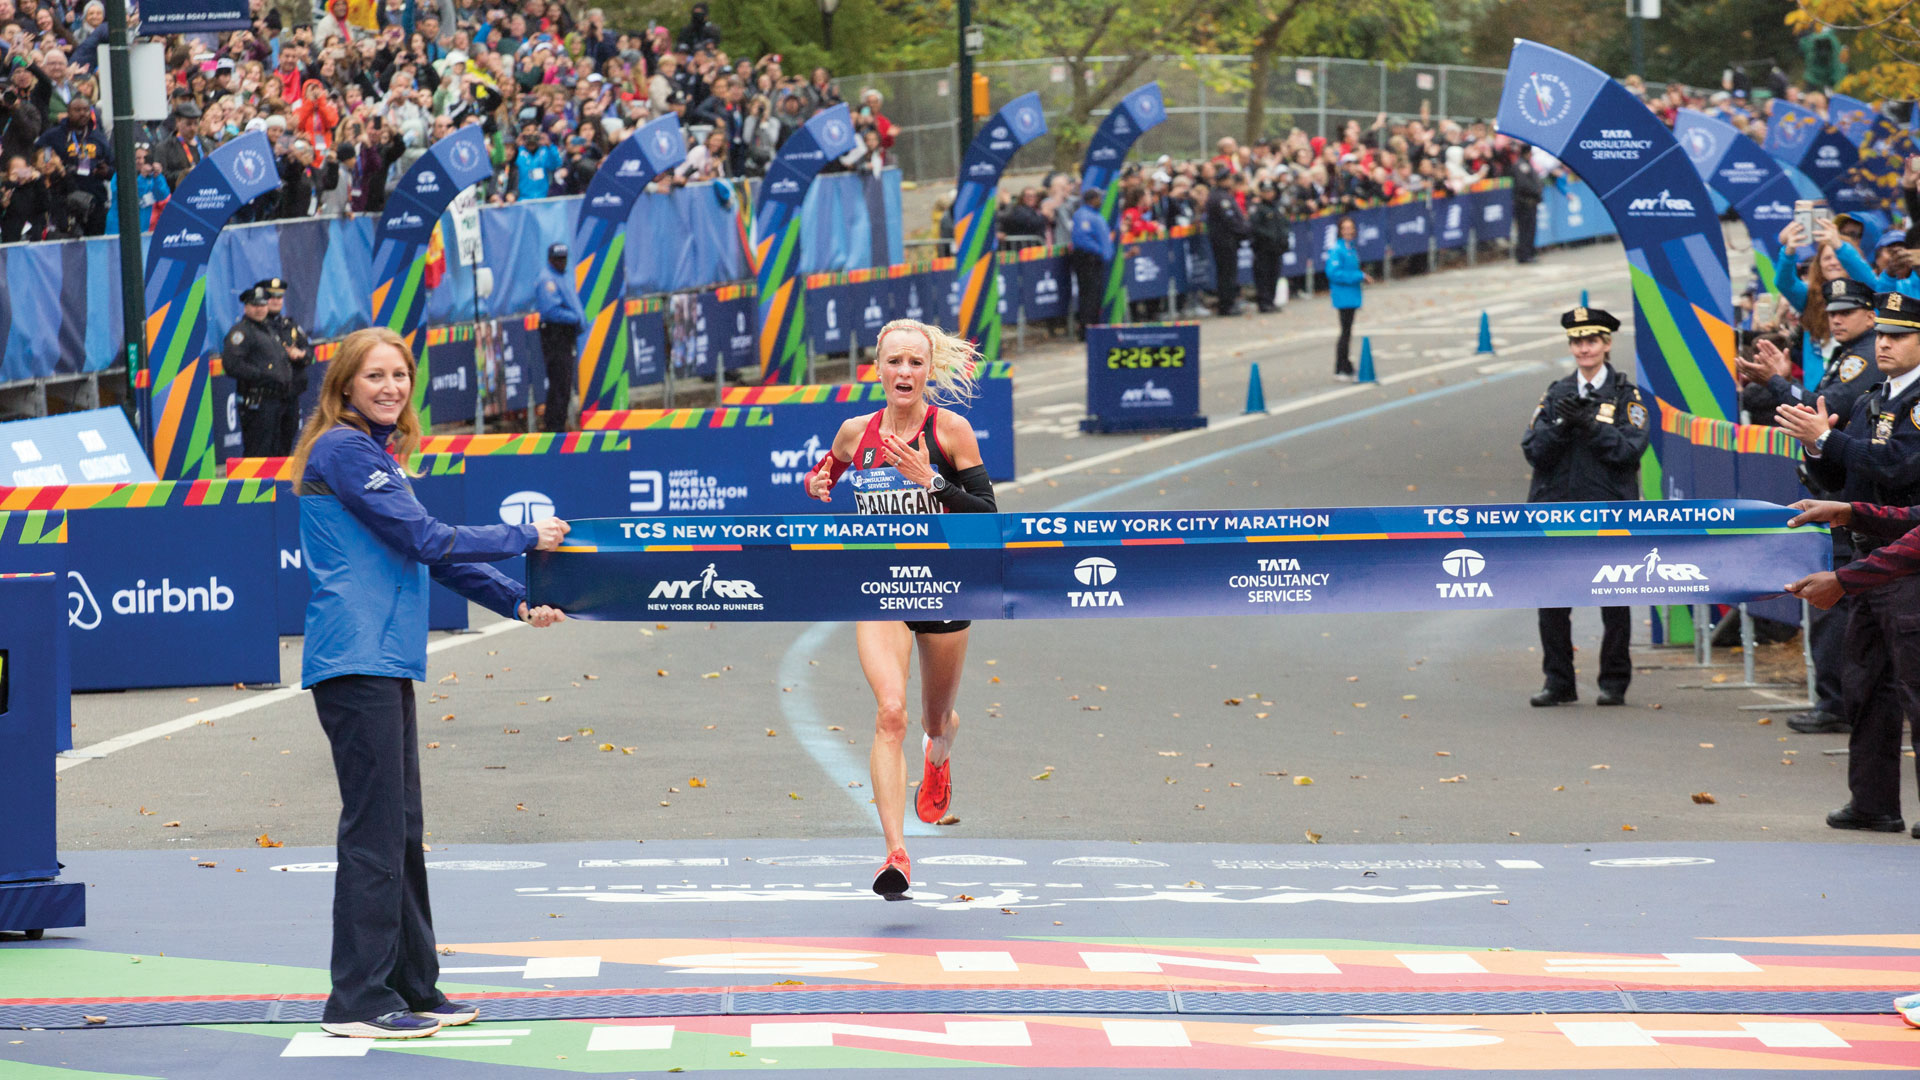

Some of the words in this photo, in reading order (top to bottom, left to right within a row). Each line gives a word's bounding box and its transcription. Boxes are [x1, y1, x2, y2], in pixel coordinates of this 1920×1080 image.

[148, 14, 166, 22] NEW
[167, 13, 186, 22] YORK
[186, 12, 207, 21] ROAD
[208, 11, 241, 20] RUNNERS
[1600, 129, 1632, 139] TATA
[1579, 140, 1652, 150] CONSULTANCY
[1592, 150, 1639, 160] SERVICES
[668, 476, 717, 489] WORLD
[668, 487, 748, 500] MARATHON
[668, 498, 725, 511] MAJORS
[1423, 508, 1469, 525] TCS
[1476, 510, 1521, 524] NEW
[1524, 509, 1576, 524] YORK
[1579, 509, 1624, 523] CITY
[1628, 507, 1736, 523] MARATHON
[620, 522, 666, 539] TCS
[673, 525, 718, 538] NEW
[720, 524, 772, 538] YORK
[776, 524, 819, 537] CITY
[823, 523, 929, 537] MARATHON
[1021, 517, 1067, 534] TCS
[1074, 519, 1118, 534] NEW
[1121, 518, 1173, 533] YORK
[1176, 517, 1219, 532] CITY
[1224, 514, 1330, 530] MARATHON
[889, 566, 933, 579] TATA
[1257, 558, 1301, 572] TATA
[1229, 572, 1330, 589] CONSULTANCY
[1591, 563, 1709, 584] NYRR
[648, 579, 764, 599] NYRR
[860, 580, 962, 595] CONSULTANCY
[1436, 582, 1494, 599] TATA
[1591, 587, 1611, 595] NEW
[1613, 587, 1638, 595] YORK
[1640, 586, 1666, 594] ROAD
[1667, 585, 1710, 593] RUNNERS
[112, 576, 235, 615] airbnb
[879, 596, 944, 610] SERVICES
[1067, 591, 1125, 608] TATA
[1247, 589, 1313, 604] SERVICES
[648, 603, 669, 611] NEW
[671, 603, 694, 611] YORK
[696, 603, 721, 611] ROAD
[722, 603, 764, 611] RUNNERS
[438, 951, 1767, 979] FINISH
[280, 1019, 1852, 1058] FINISH
